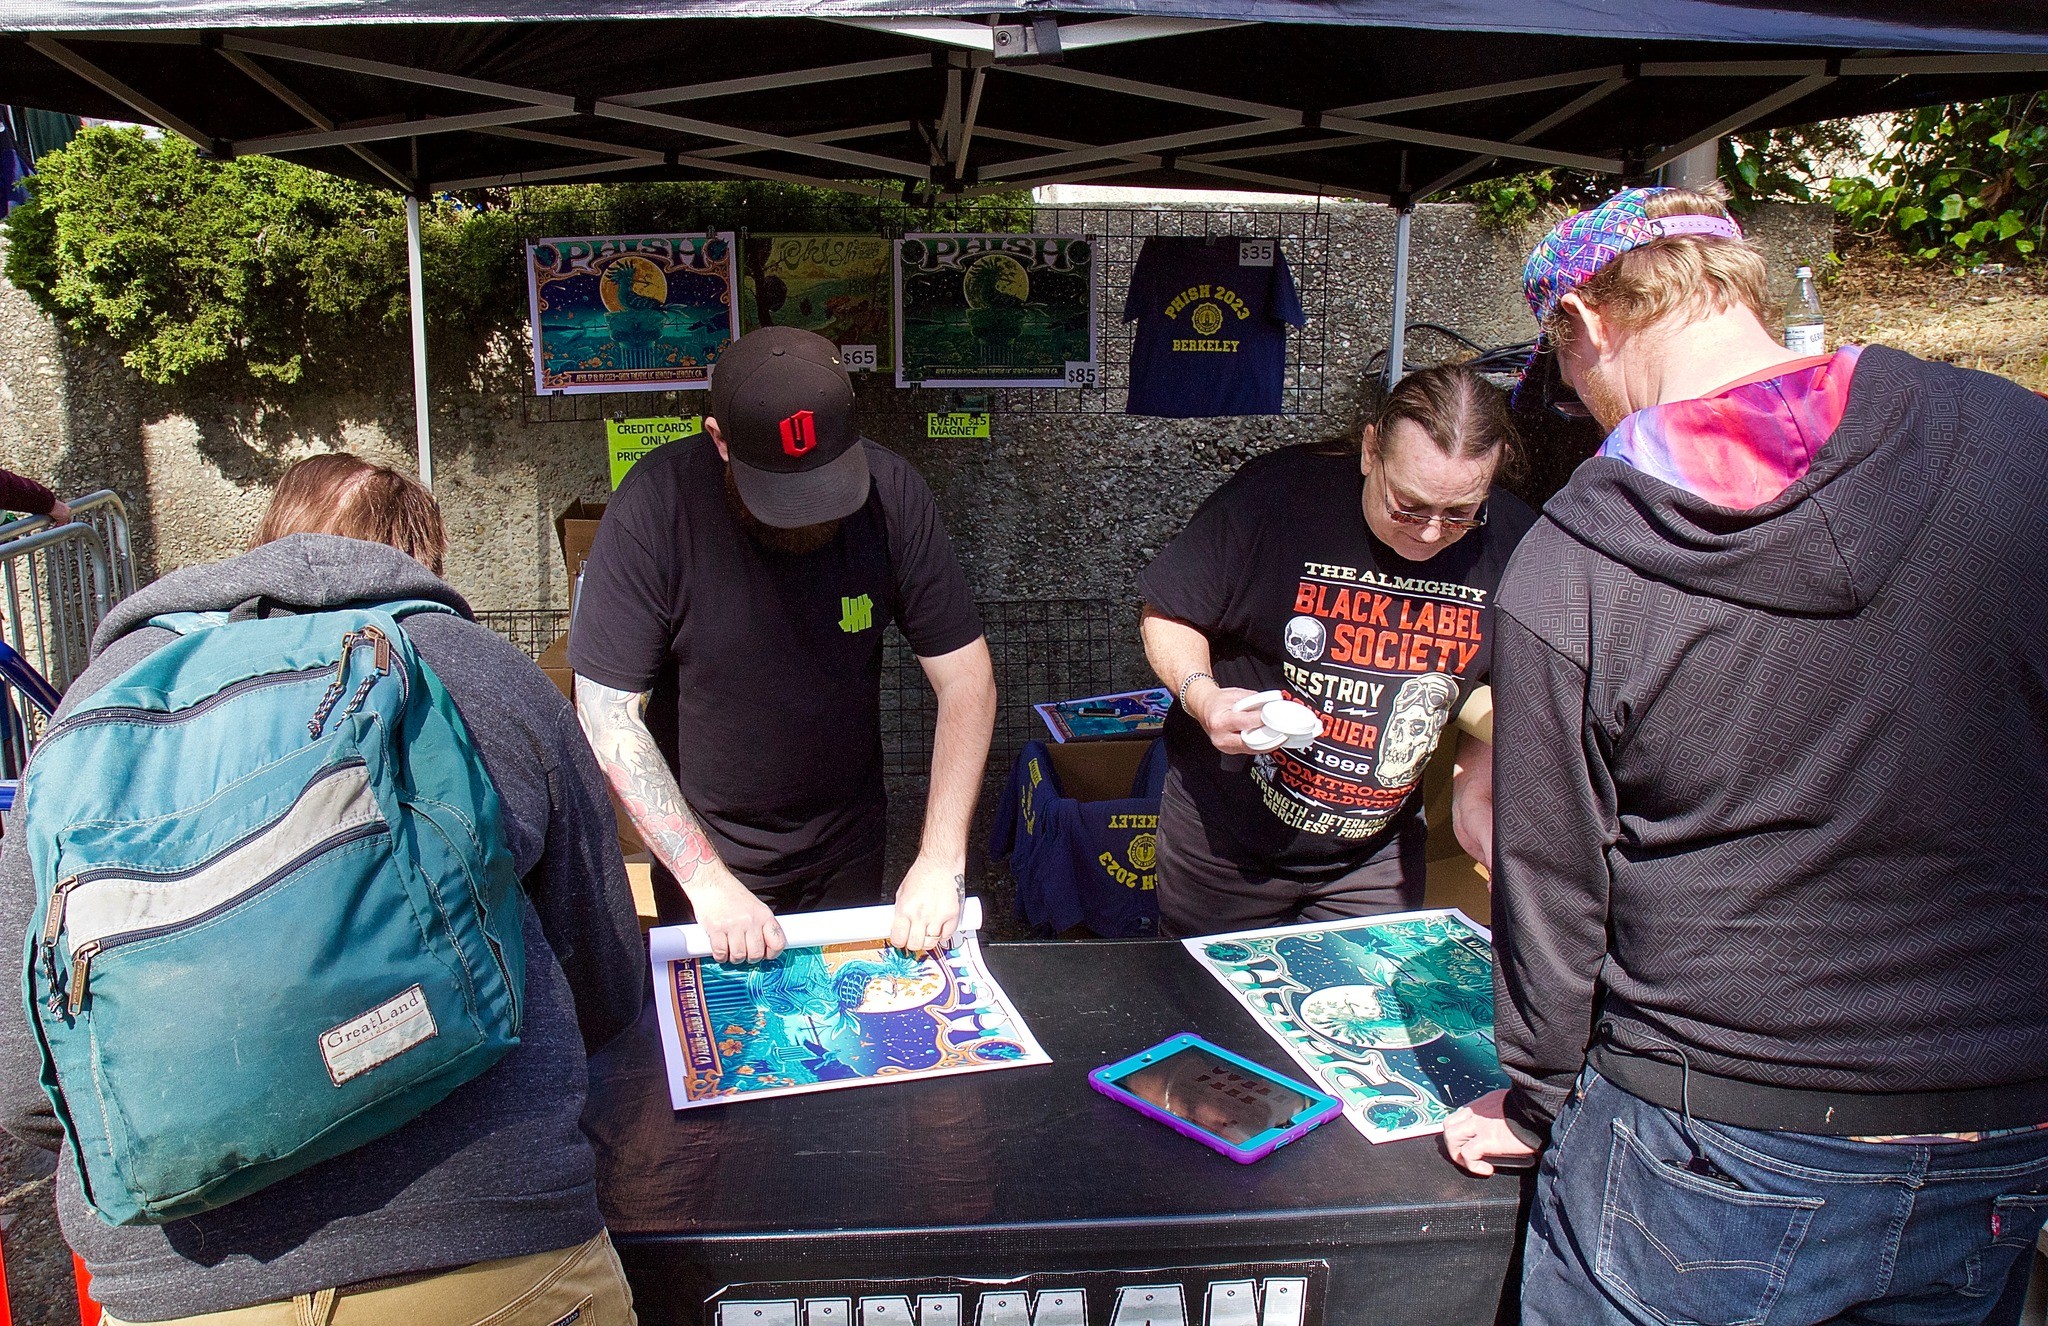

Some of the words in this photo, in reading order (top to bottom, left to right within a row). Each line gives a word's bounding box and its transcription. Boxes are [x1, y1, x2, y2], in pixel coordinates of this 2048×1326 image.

[1241, 246, 1272, 260] $35
[1165, 284, 1211, 320] PHISH
[1214, 286, 1250, 320] 2023
[1172, 339, 1240, 352] BERKELEY
[843, 350, 875, 365] $65
[1068, 368, 1096, 384] $85
[617, 424, 655, 435] CREDIT
[656, 422, 693, 434] CARDS
[930, 416, 964, 426] EVENT
[968, 415, 987, 427] $15
[930, 426, 978, 436] MAGNET
[641, 436, 671, 446] ONLY
[1304, 562, 1357, 581] THE
[1359, 570, 1487, 603] ALMIGHTY
[1293, 582, 1393, 627] BLACK
[1398, 599, 1483, 641] LABEL
[1330, 623, 1480, 675] SOCIETY
[1283, 661, 1385, 708] DESTROY
[1323, 699, 1334, 714] &
[1314, 750, 1370, 775] 1998
[1250, 766, 1308, 818] STRENGTH
[1108, 814, 1160, 829] KELEY
[1099, 852, 1138, 888] 2023
